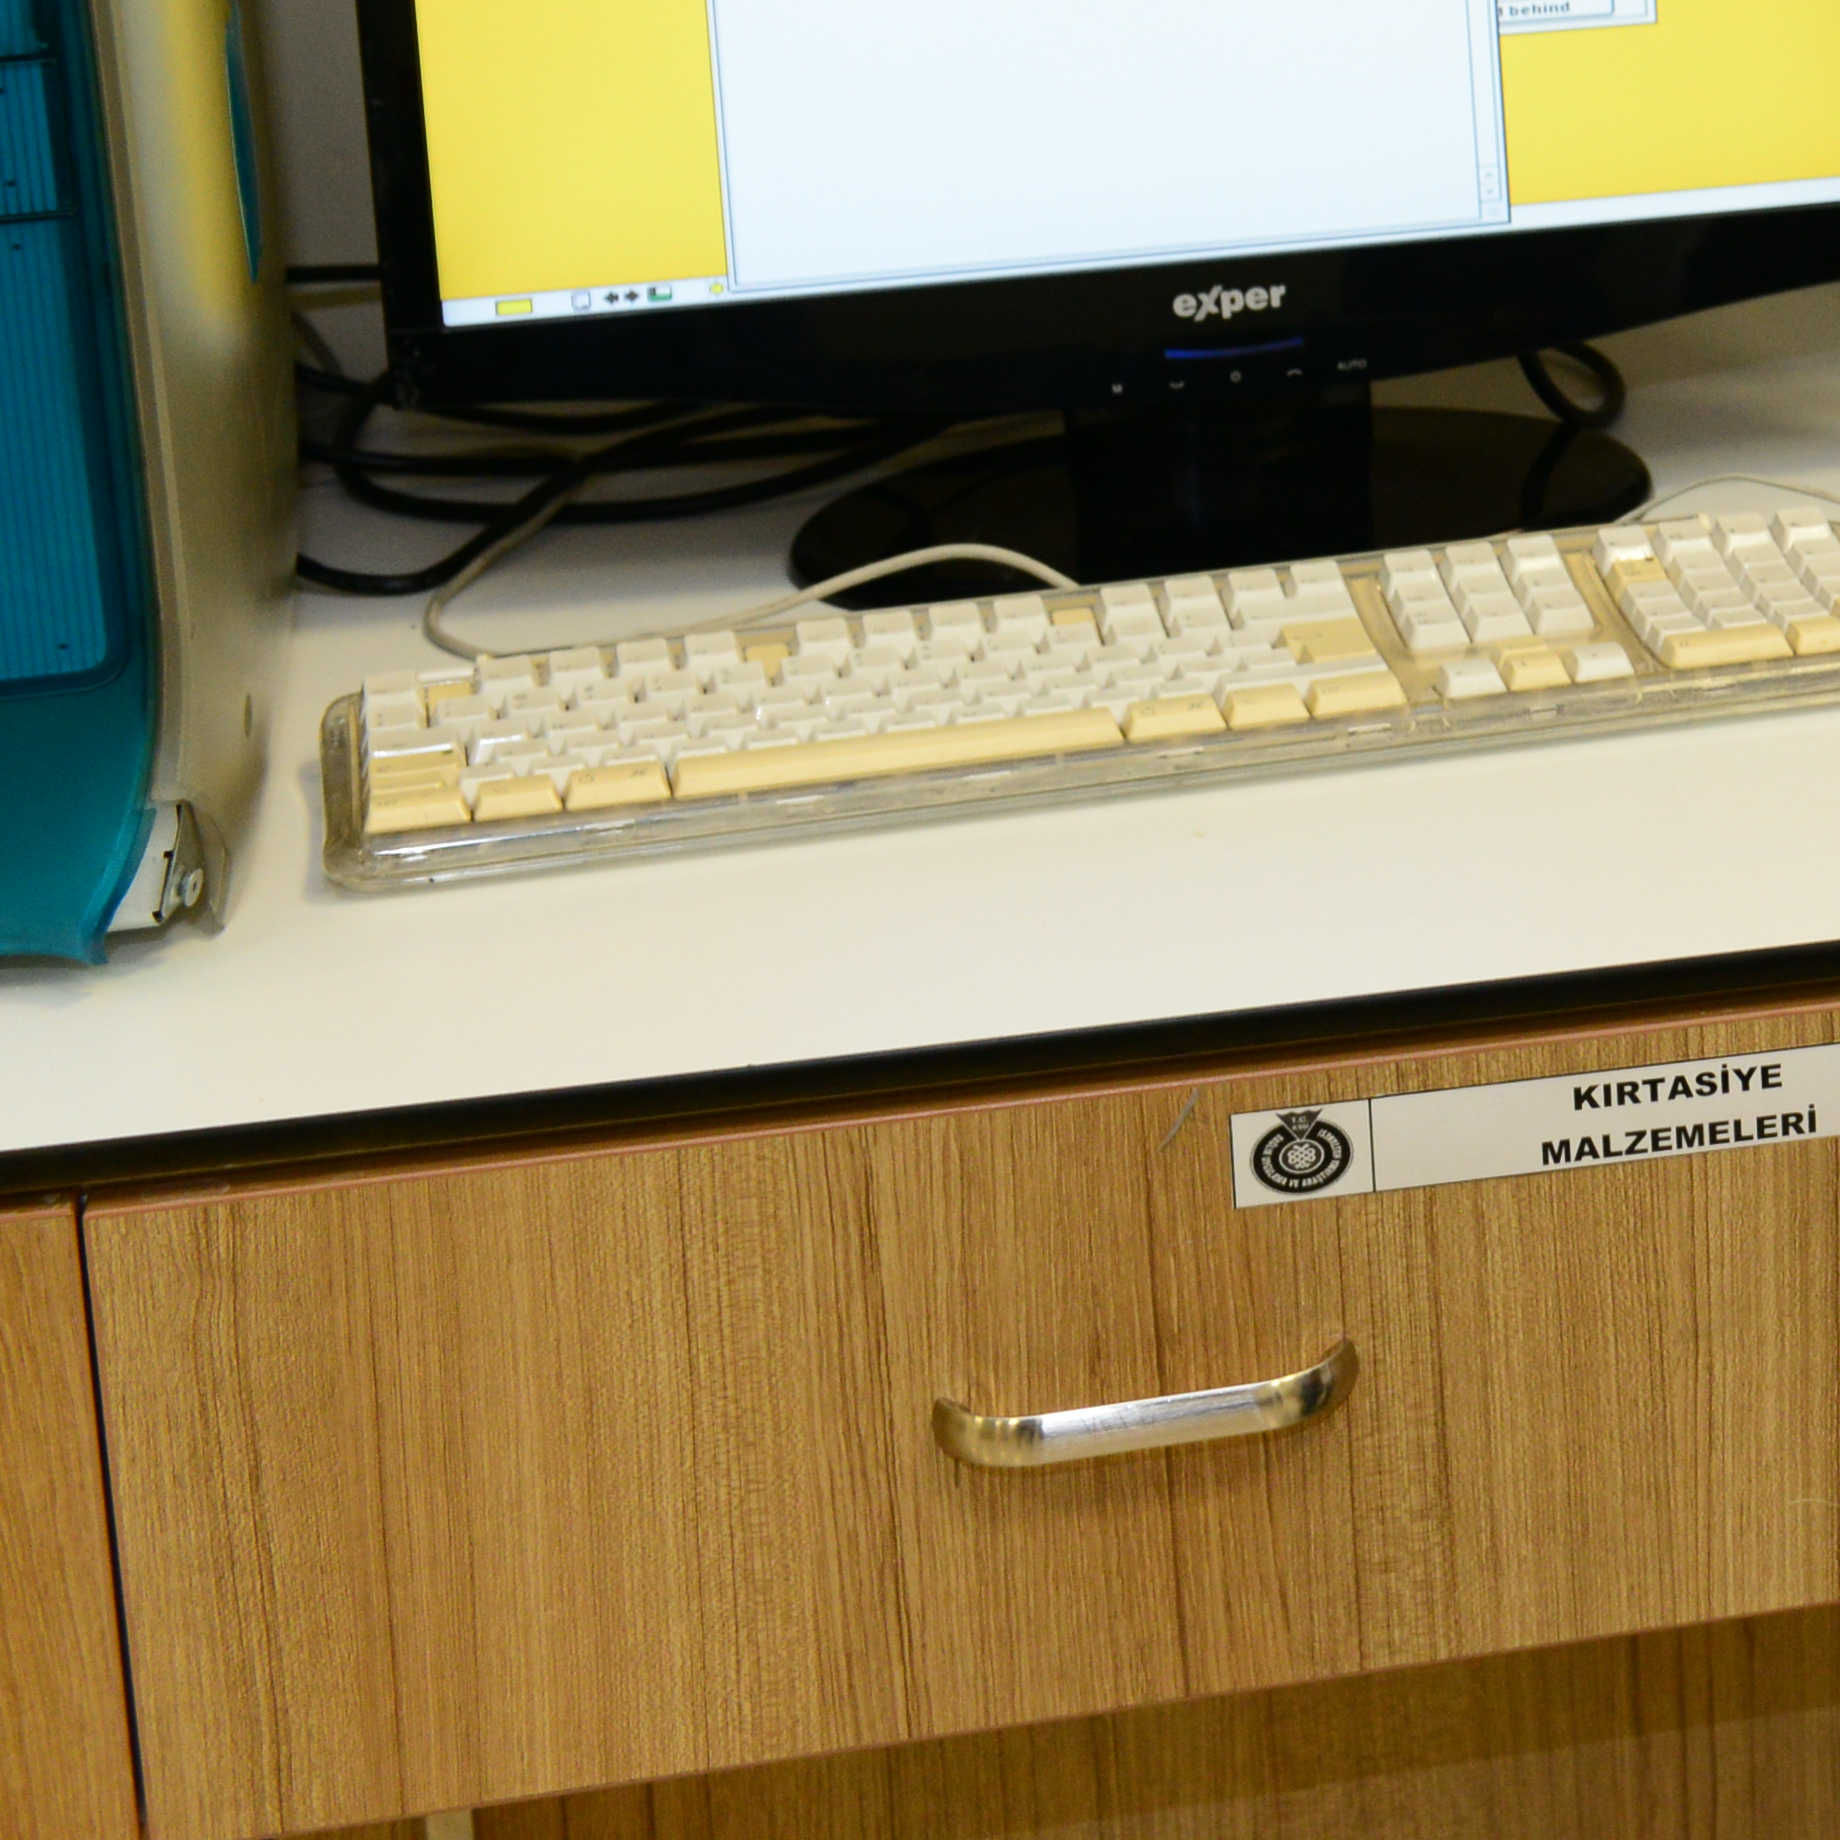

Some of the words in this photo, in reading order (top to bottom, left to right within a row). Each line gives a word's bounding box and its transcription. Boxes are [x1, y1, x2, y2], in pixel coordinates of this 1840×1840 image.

[1508, 0, 1571, 17] behind
[1172, 284, 1287, 322] exper
[1571, 1062, 1785, 1113] KIRTASİYE
[1539, 1108, 1819, 1168] MALZEMELERİ
